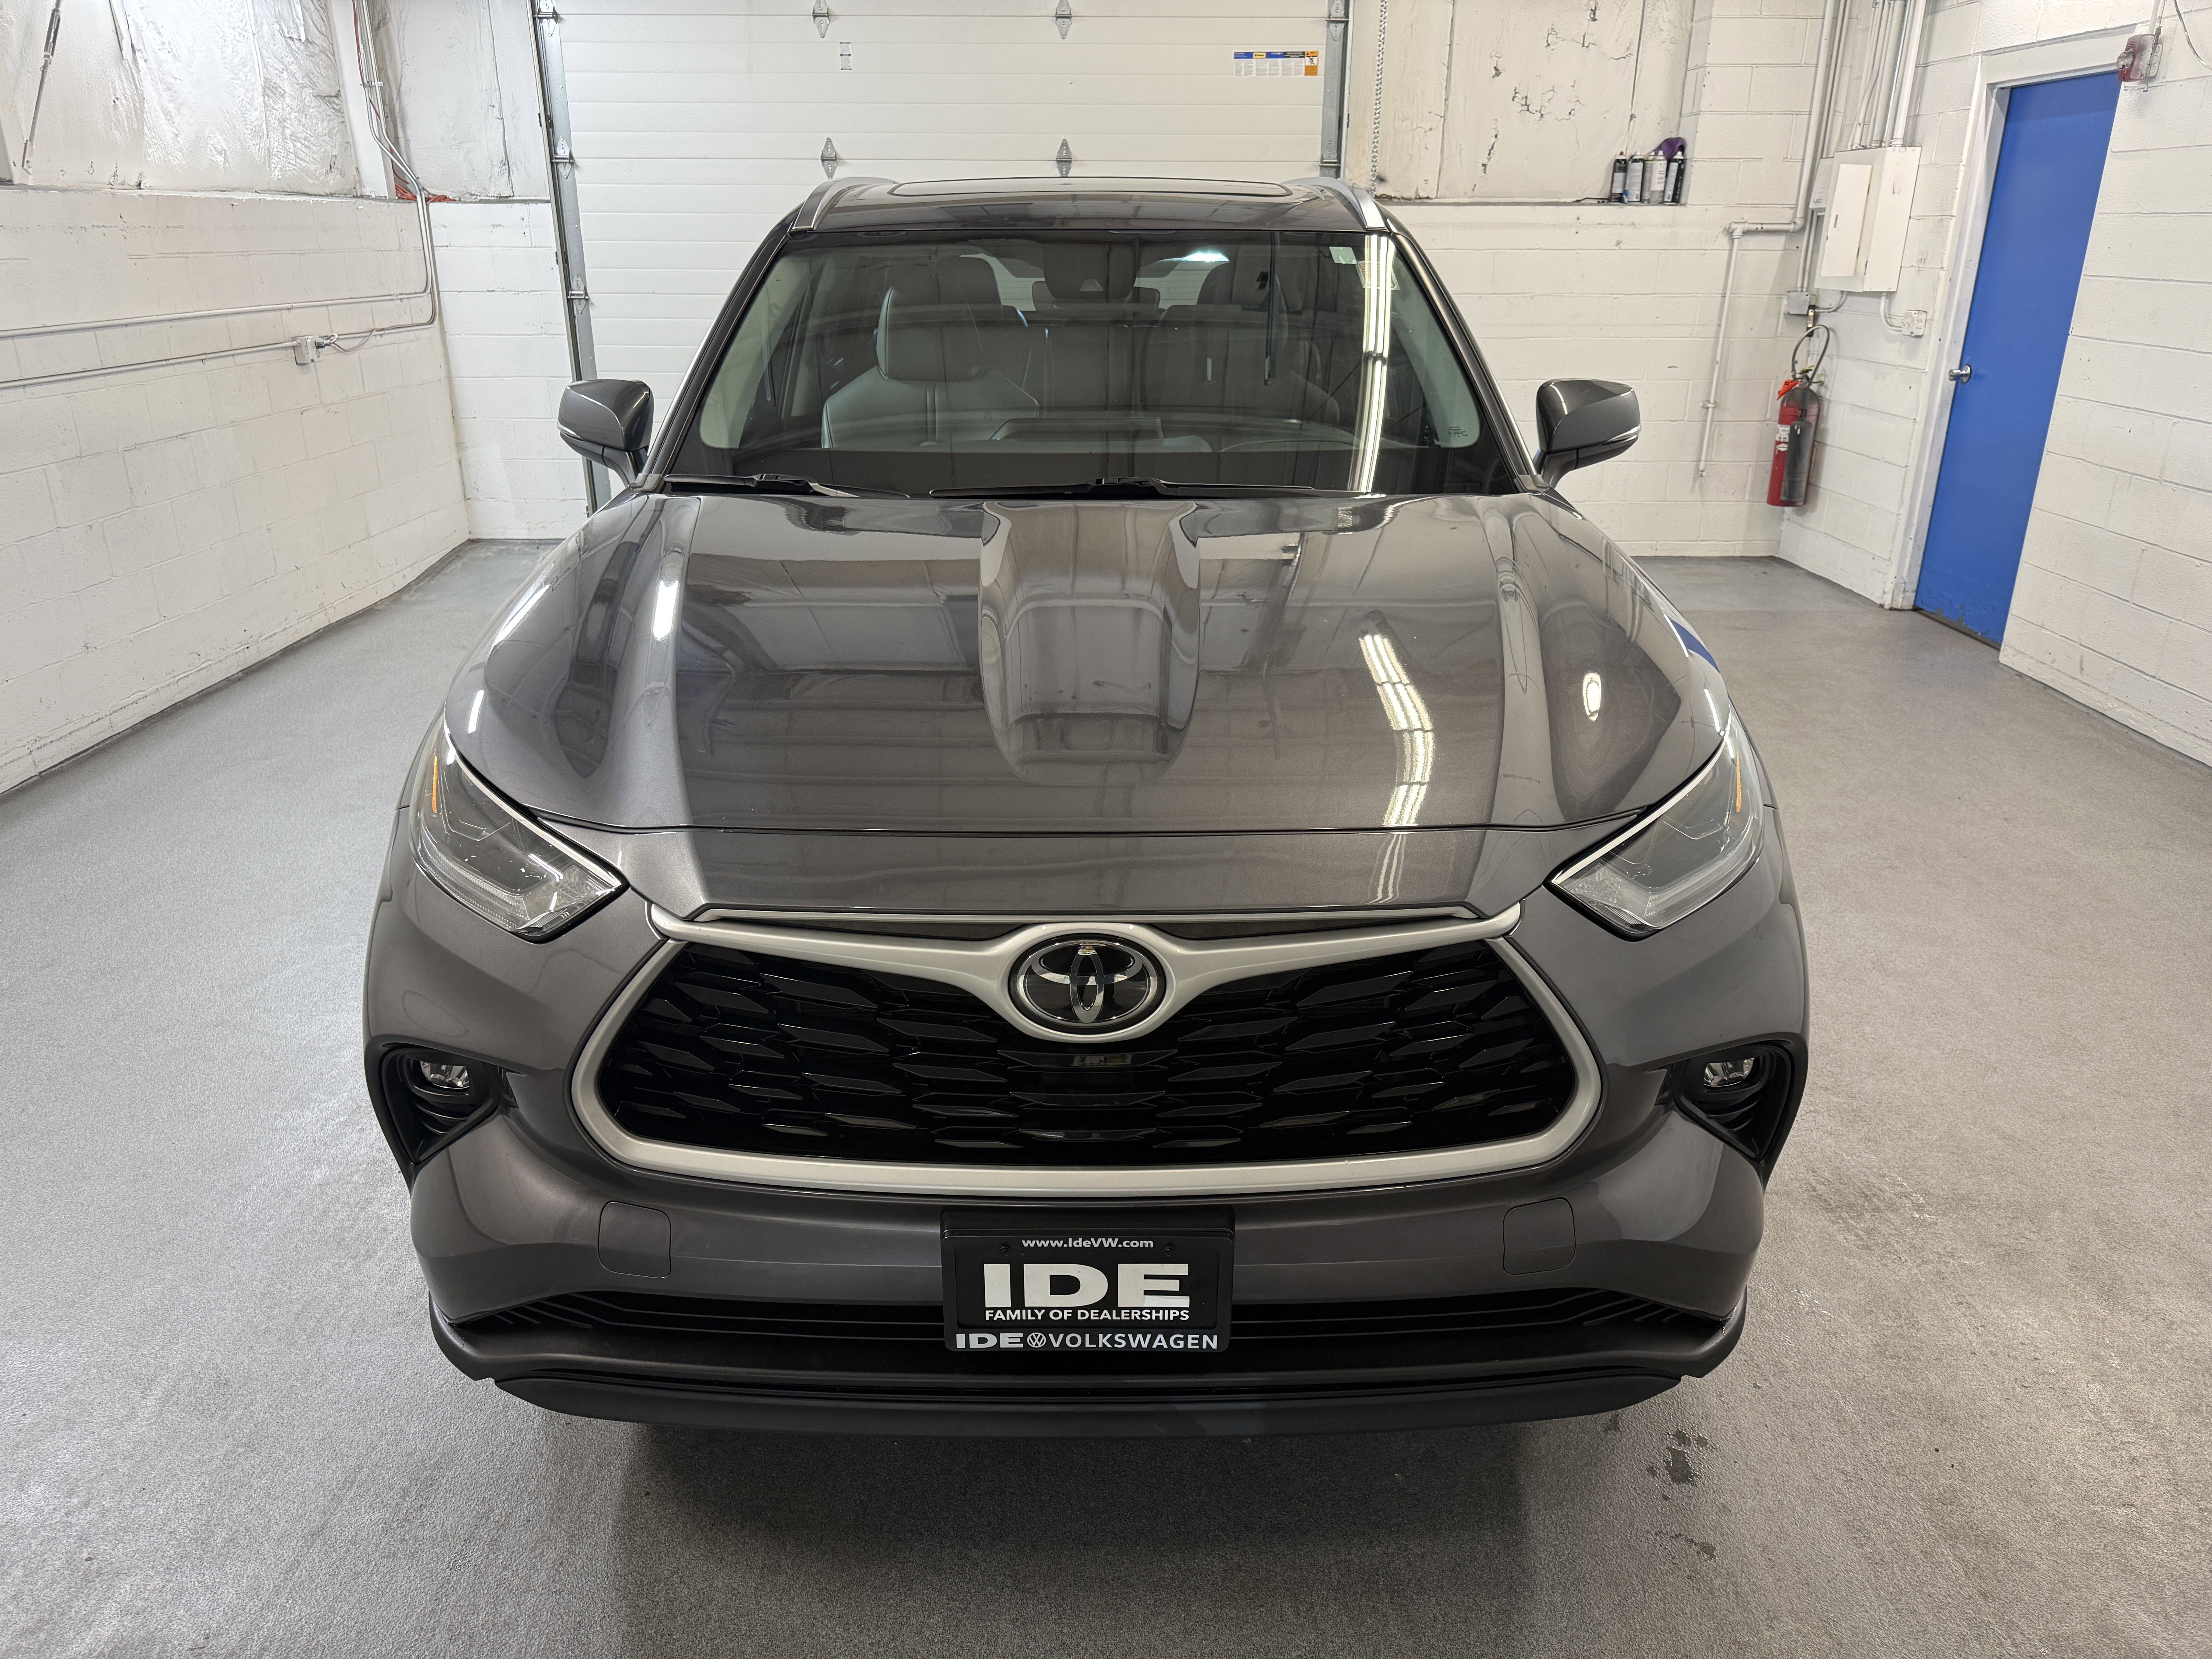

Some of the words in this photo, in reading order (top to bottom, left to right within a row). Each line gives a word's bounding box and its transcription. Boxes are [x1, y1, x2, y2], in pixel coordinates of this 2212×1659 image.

[1022, 1238, 1153, 1247] www.IdeVW.com
[984, 1264, 1190, 1307] IDE
[986, 1310, 1045, 1320] FAMILY
[1049, 1310, 1072, 1320] OF
[1078, 1310, 1189, 1320] DEALERSHIPS
[957, 1333, 1023, 1348] IDE
[1049, 1334, 1217, 1349] VOLKSWAGEN
